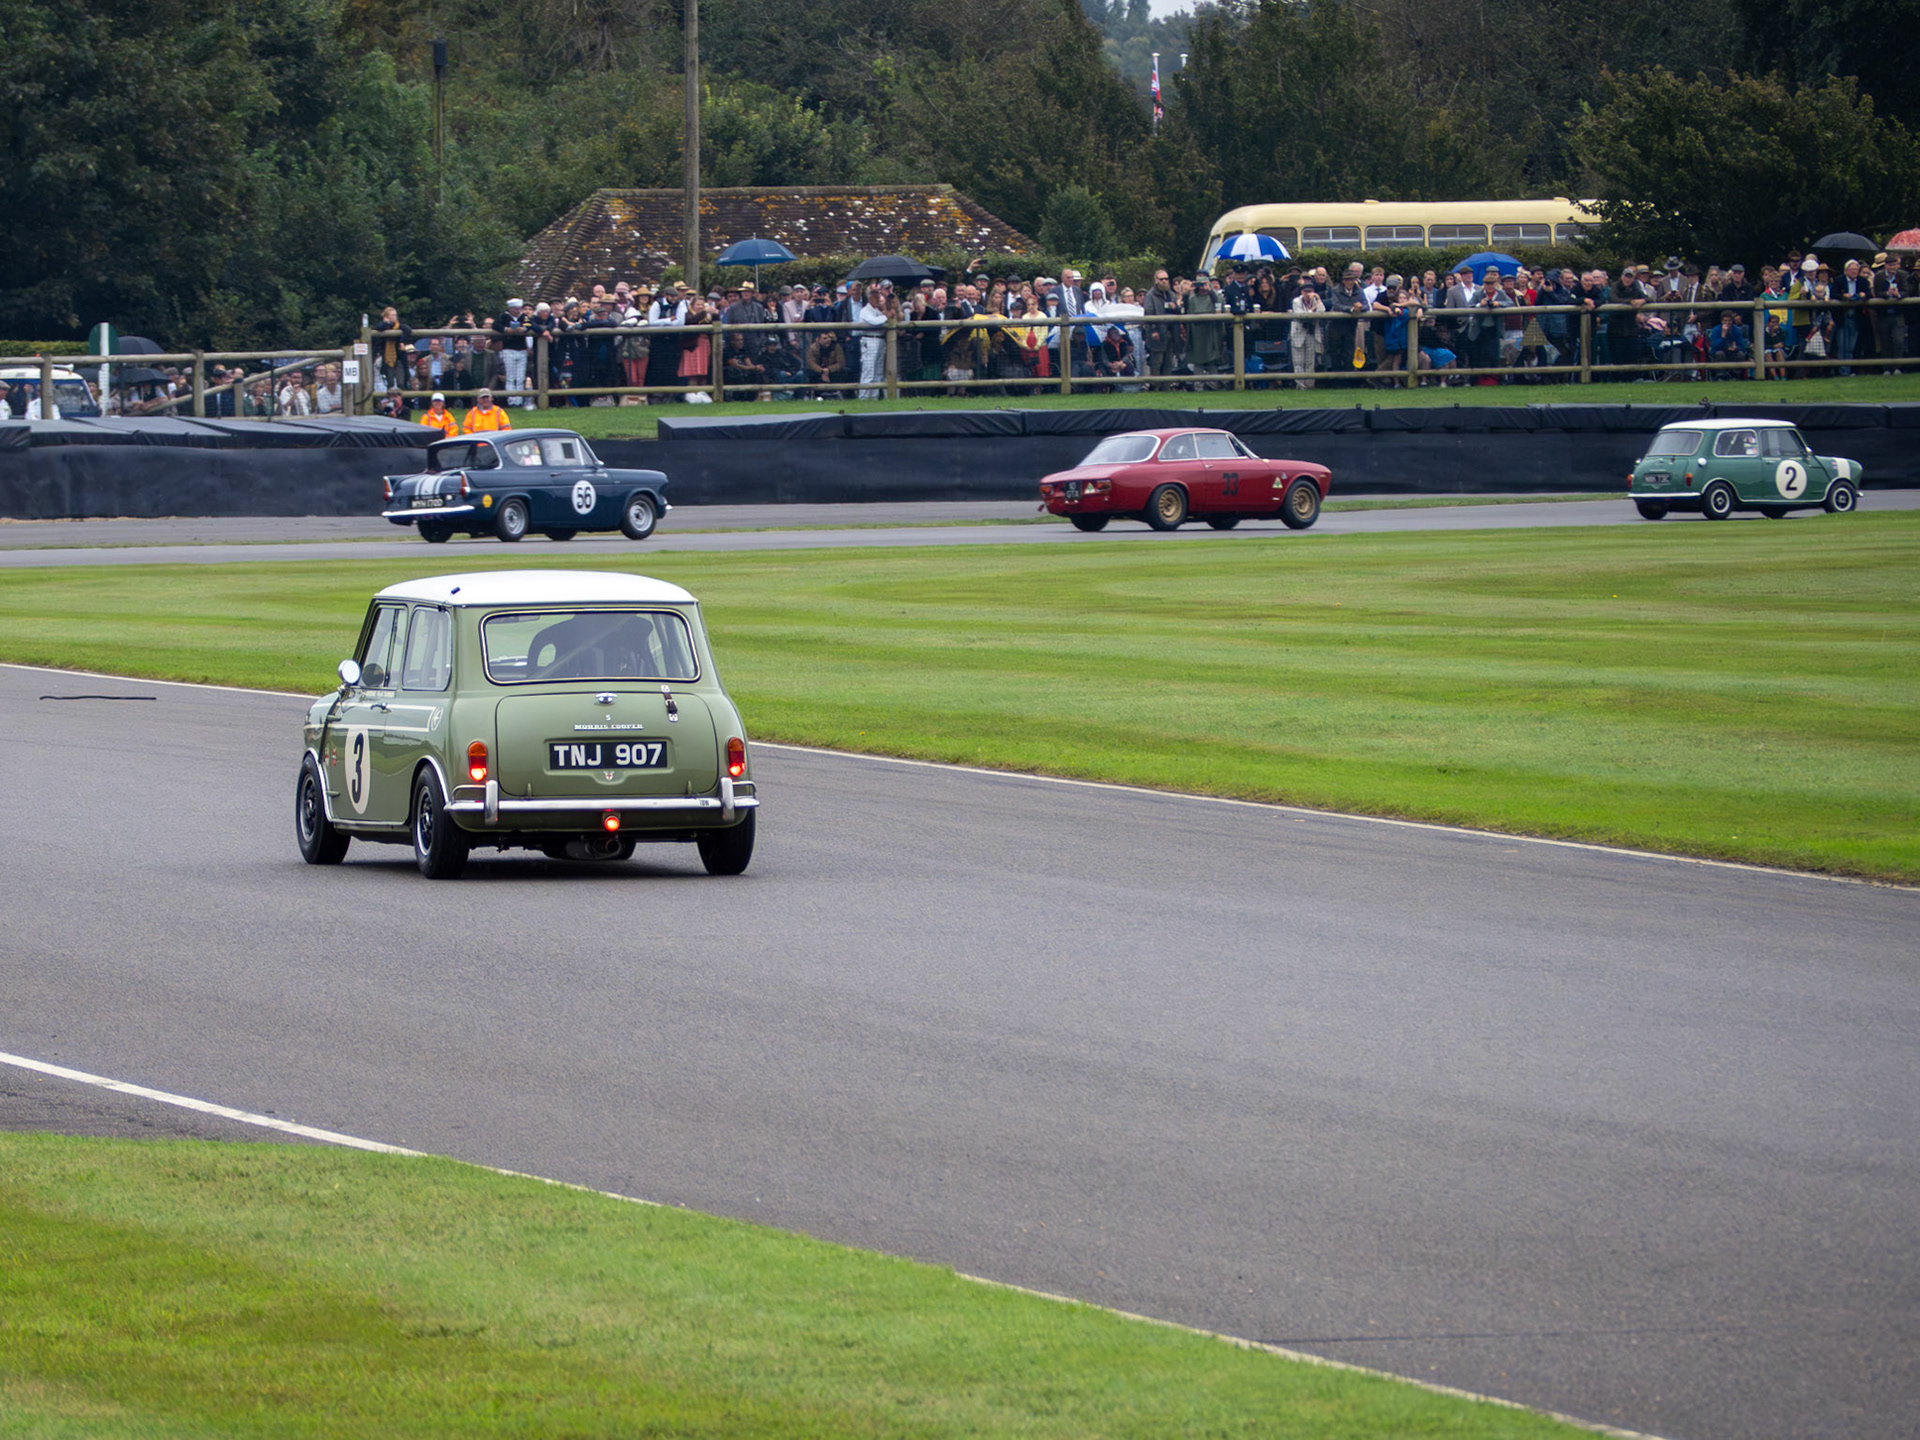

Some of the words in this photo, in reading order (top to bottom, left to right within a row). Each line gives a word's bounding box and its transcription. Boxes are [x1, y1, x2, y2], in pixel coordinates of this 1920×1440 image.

[345, 367, 358, 377] MB
[1222, 472, 1239, 496] 33
[1785, 466, 1797, 491] 2
[577, 486, 592, 509] 56
[553, 744, 602, 767] TNJ
[615, 743, 663, 766] 907
[351, 732, 364, 804] 3
